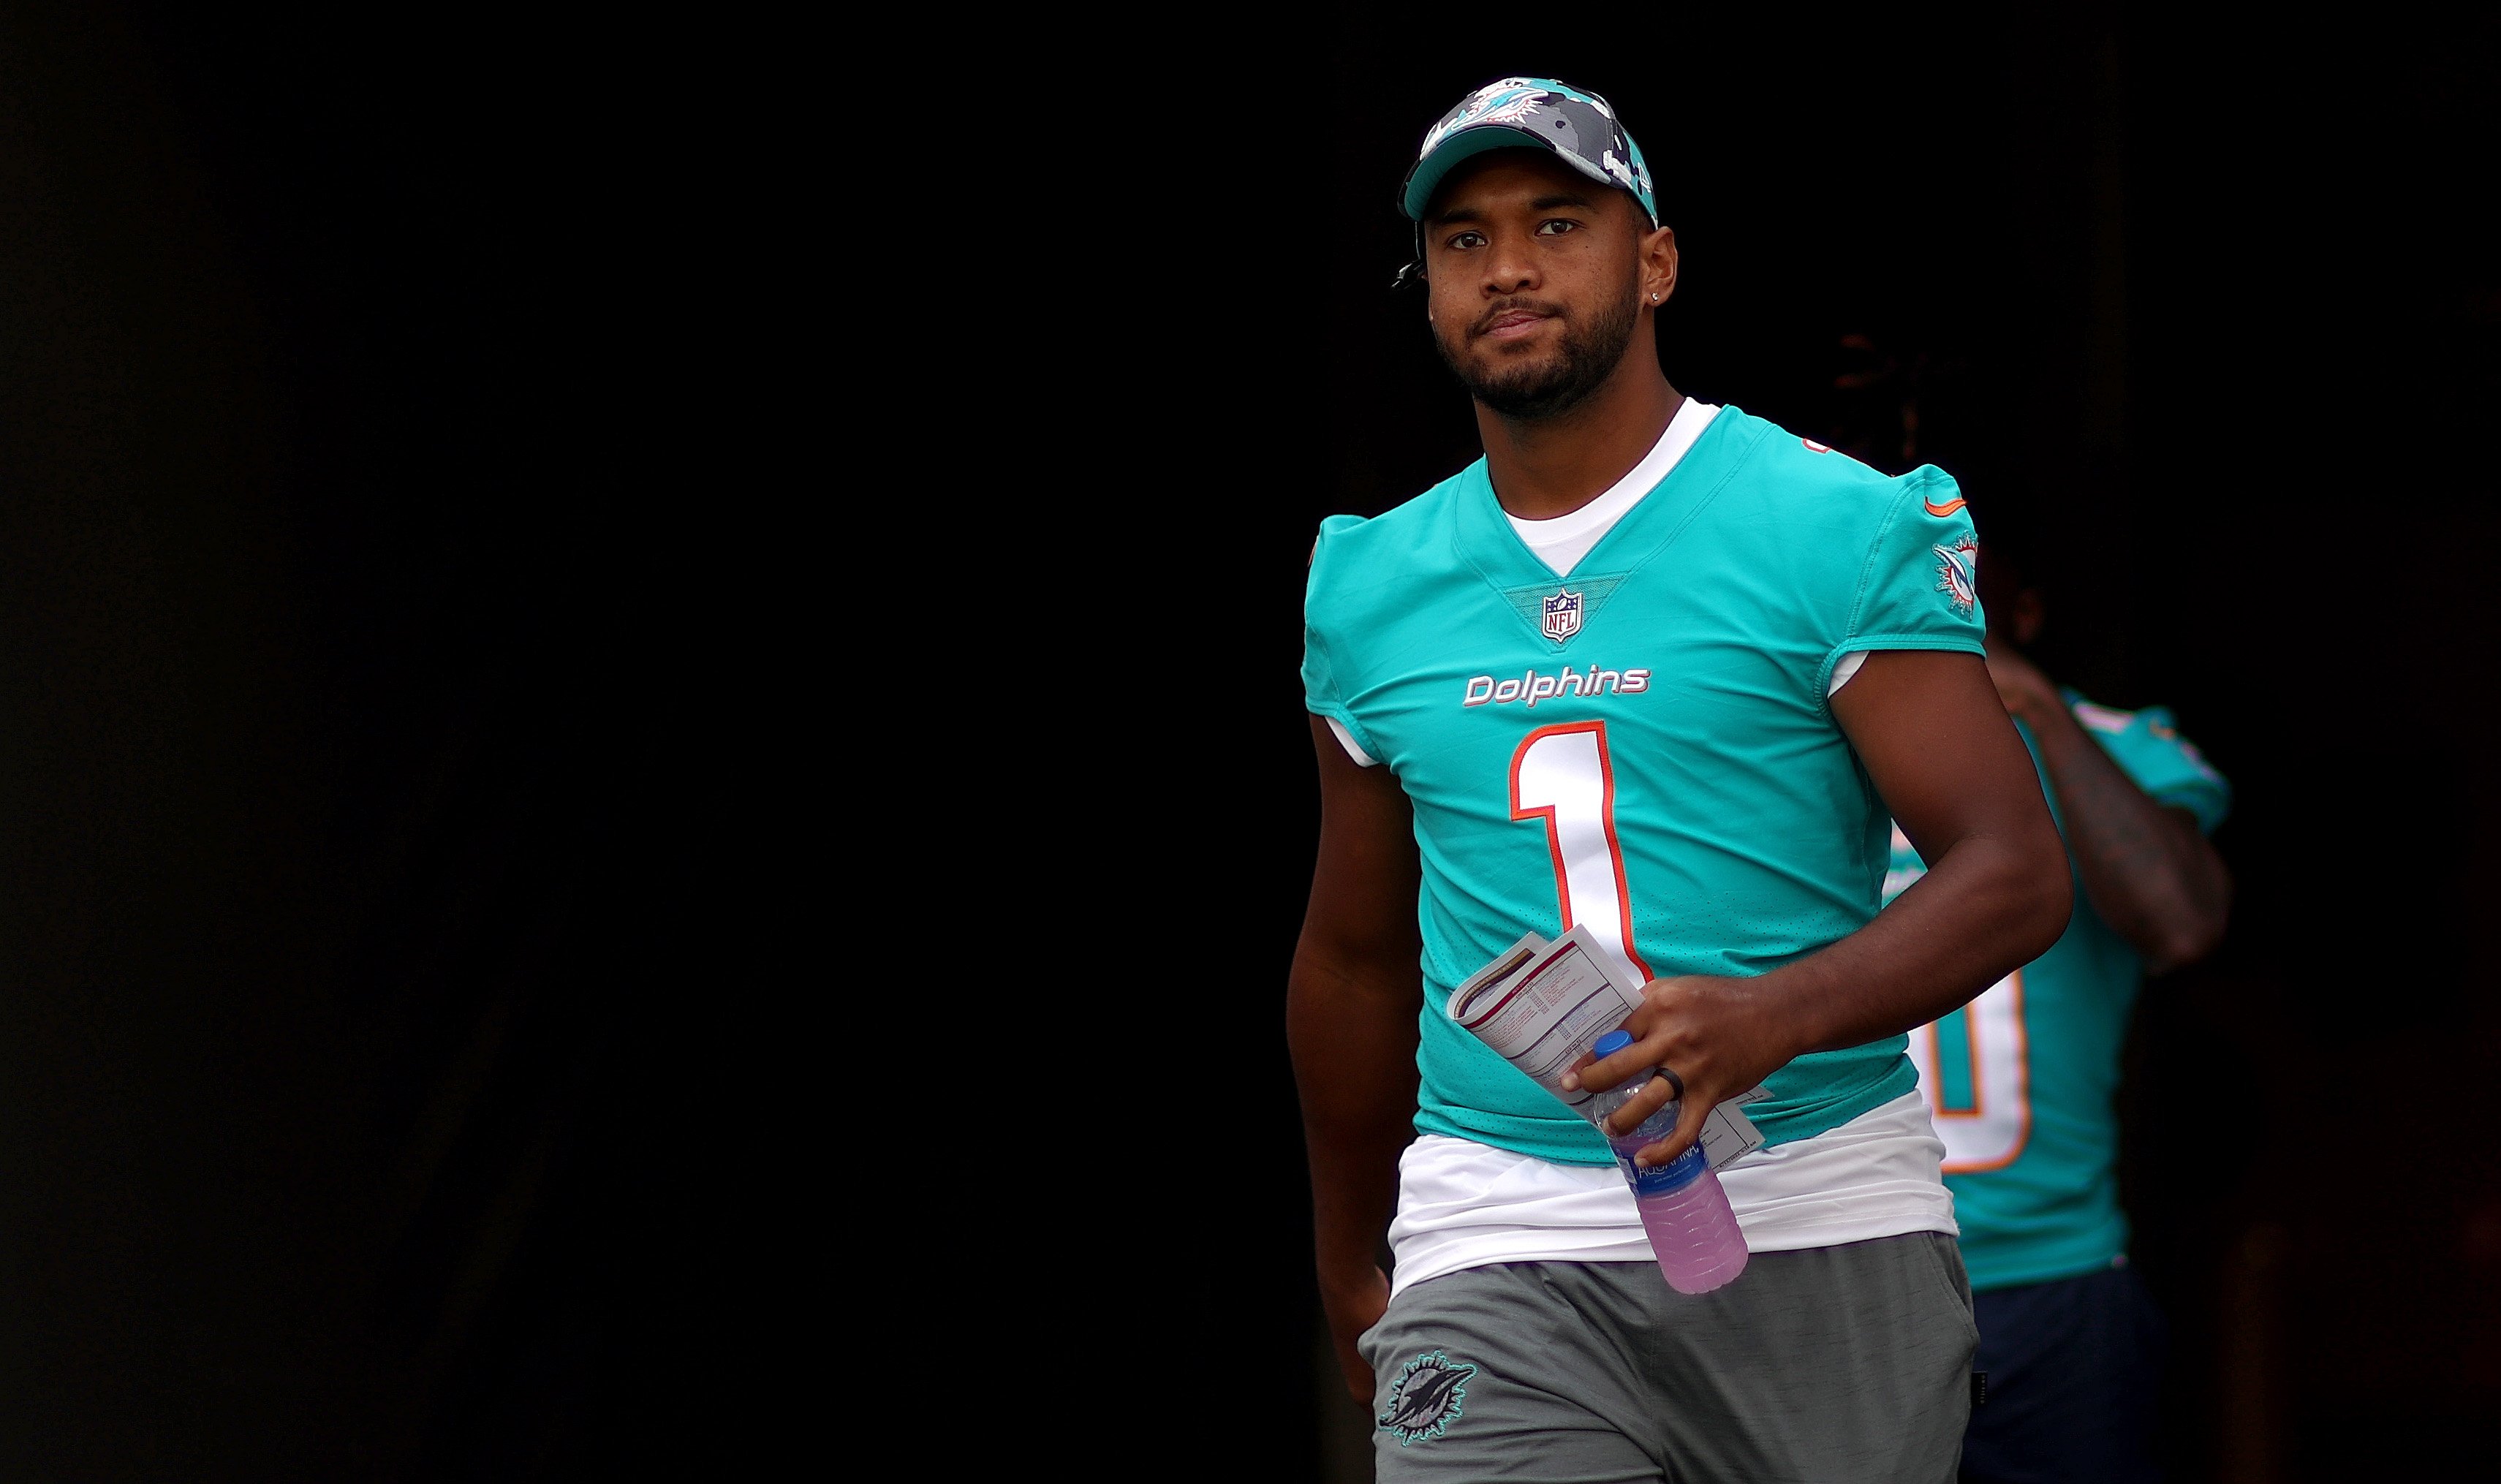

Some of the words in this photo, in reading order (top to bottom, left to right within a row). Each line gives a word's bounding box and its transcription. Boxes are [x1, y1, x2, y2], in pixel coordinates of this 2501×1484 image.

[1548, 612, 1575, 632] NFL
[1463, 663, 1651, 708] Dolphins
[1508, 719, 1655, 985] 1
